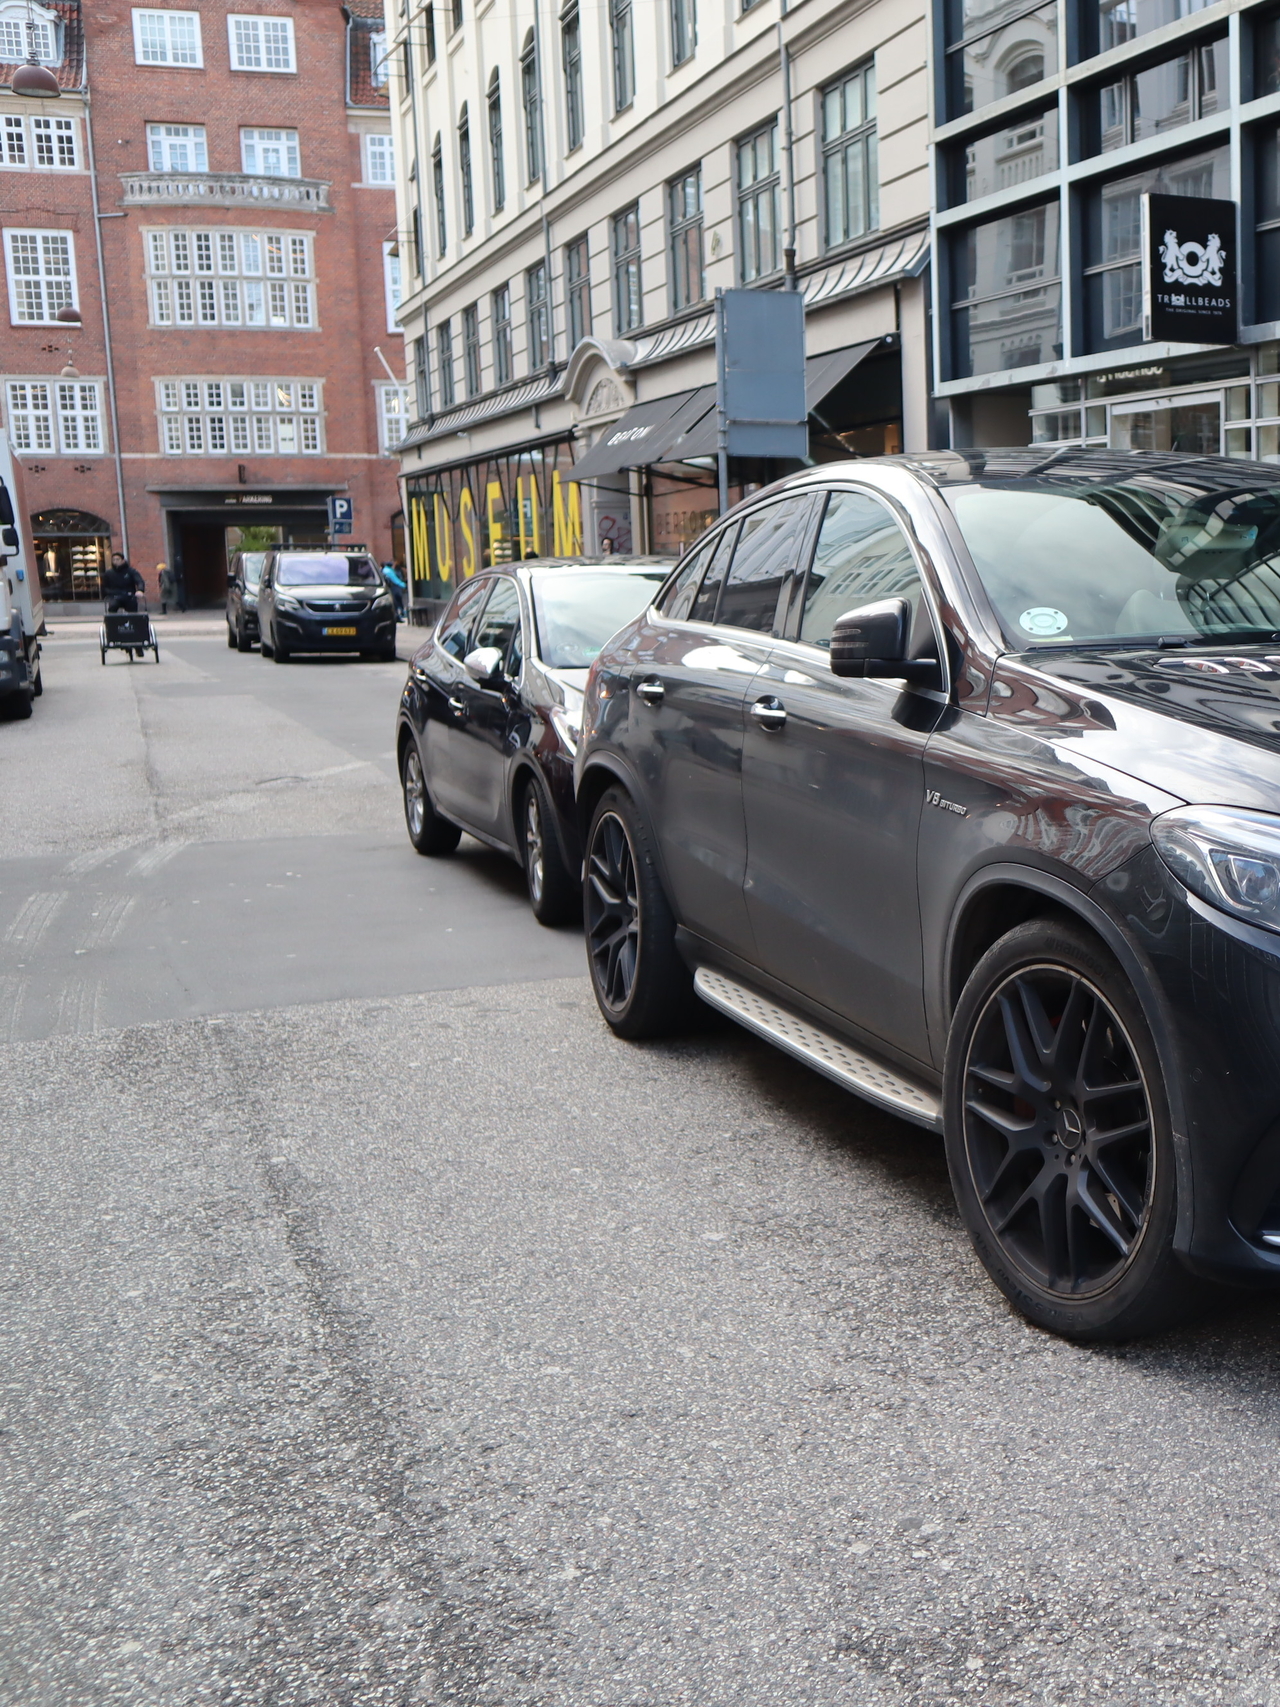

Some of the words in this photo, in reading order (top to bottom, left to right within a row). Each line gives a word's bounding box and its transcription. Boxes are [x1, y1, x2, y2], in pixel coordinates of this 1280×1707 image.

[335, 499, 348, 518] P
[411, 469, 582, 583] MUSEUM
[926, 789, 940, 805] V8
[939, 799, 967, 815] BITURBO
